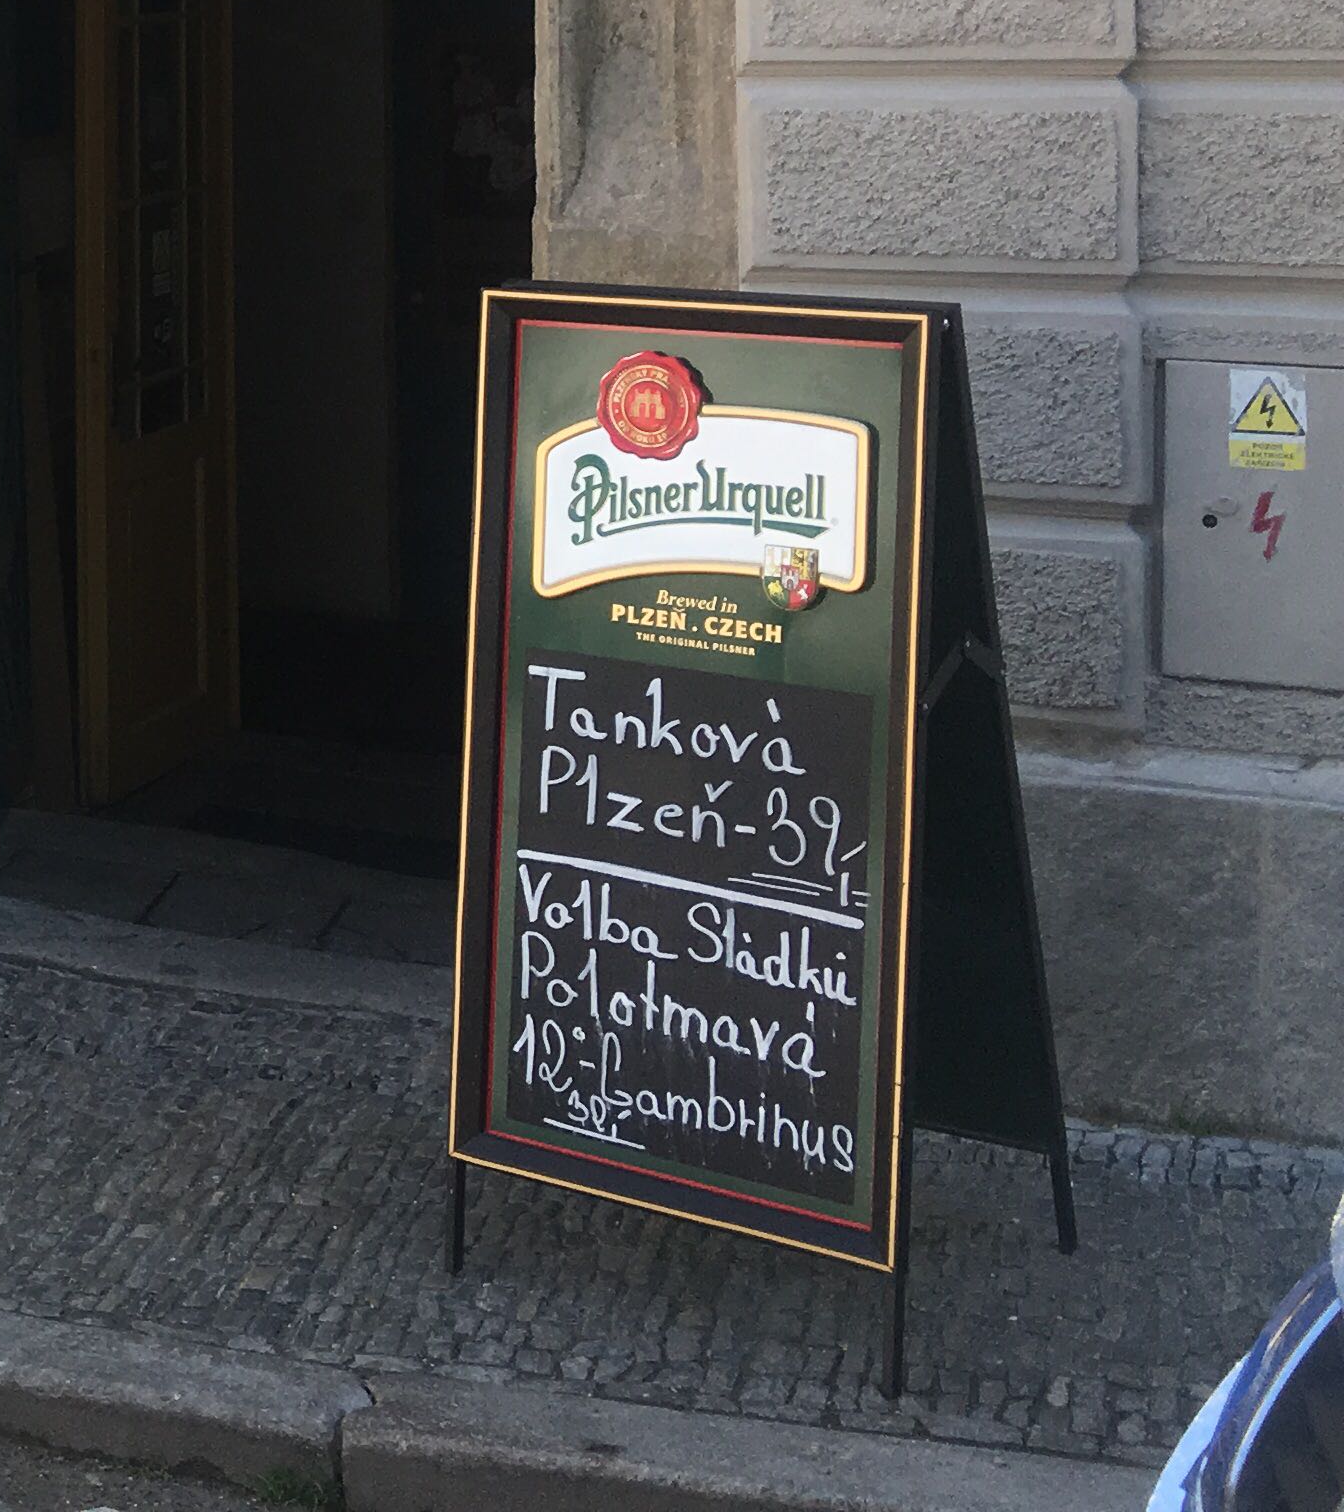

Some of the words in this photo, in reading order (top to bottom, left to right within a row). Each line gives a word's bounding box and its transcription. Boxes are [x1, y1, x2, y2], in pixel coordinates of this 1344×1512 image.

[568, 453, 699, 547] Pilsner
[696, 458, 828, 537] Urquell
[656, 589, 718, 612] Brewed
[720, 596, 738, 614] in
[610, 603, 688, 631] PLZEŇ
[703, 616, 783, 644] CZECH
[635, 631, 656, 643] THE
[658, 634, 710, 650] ORIGINAL
[712, 642, 756, 656] PILSNER
